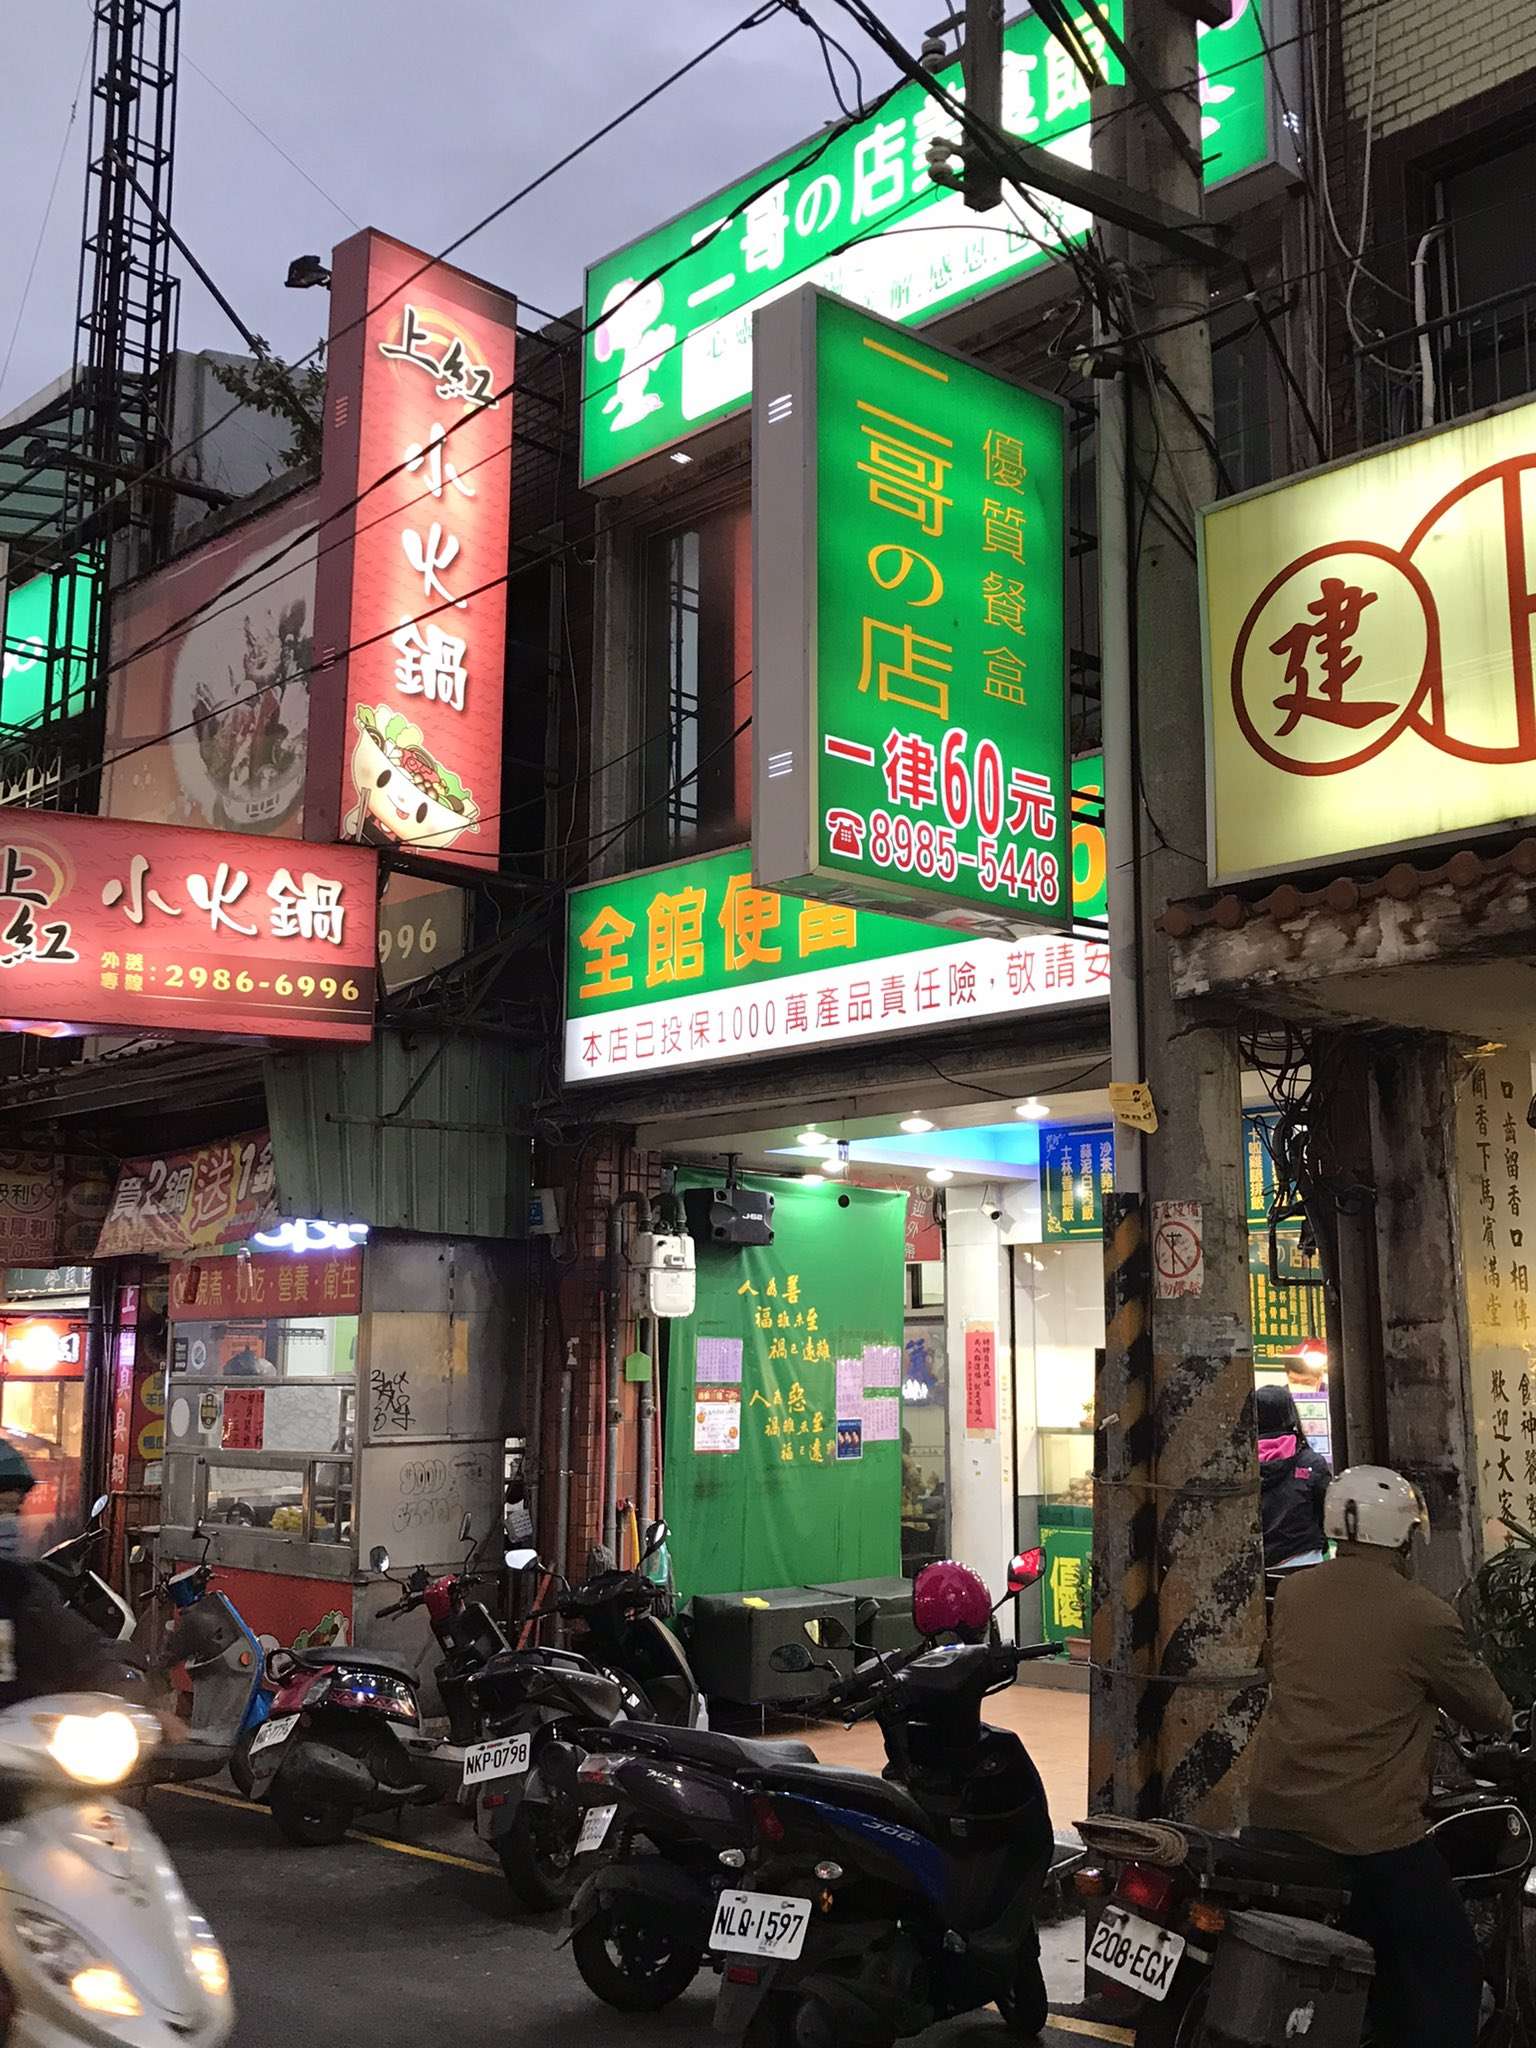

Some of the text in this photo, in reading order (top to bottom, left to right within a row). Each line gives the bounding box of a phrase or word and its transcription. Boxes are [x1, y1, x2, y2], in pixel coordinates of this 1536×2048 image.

[379, 302, 501, 711] 上紅 小火鍋
[857, 336, 953, 722] 二哥の店
[981, 427, 1028, 707] 優質餐盒
[1268, 577, 1401, 737] 建
[824, 726, 1057, 843] 一律60元
[101, 854, 346, 945] 小火鍋
[869, 808, 1059, 907] 8985-5448
[465, 1743, 528, 1776] NKP-0798
[714, 1904, 805, 1945] NLQ-1597
[1091, 1926, 1174, 1990] 208-EGX
